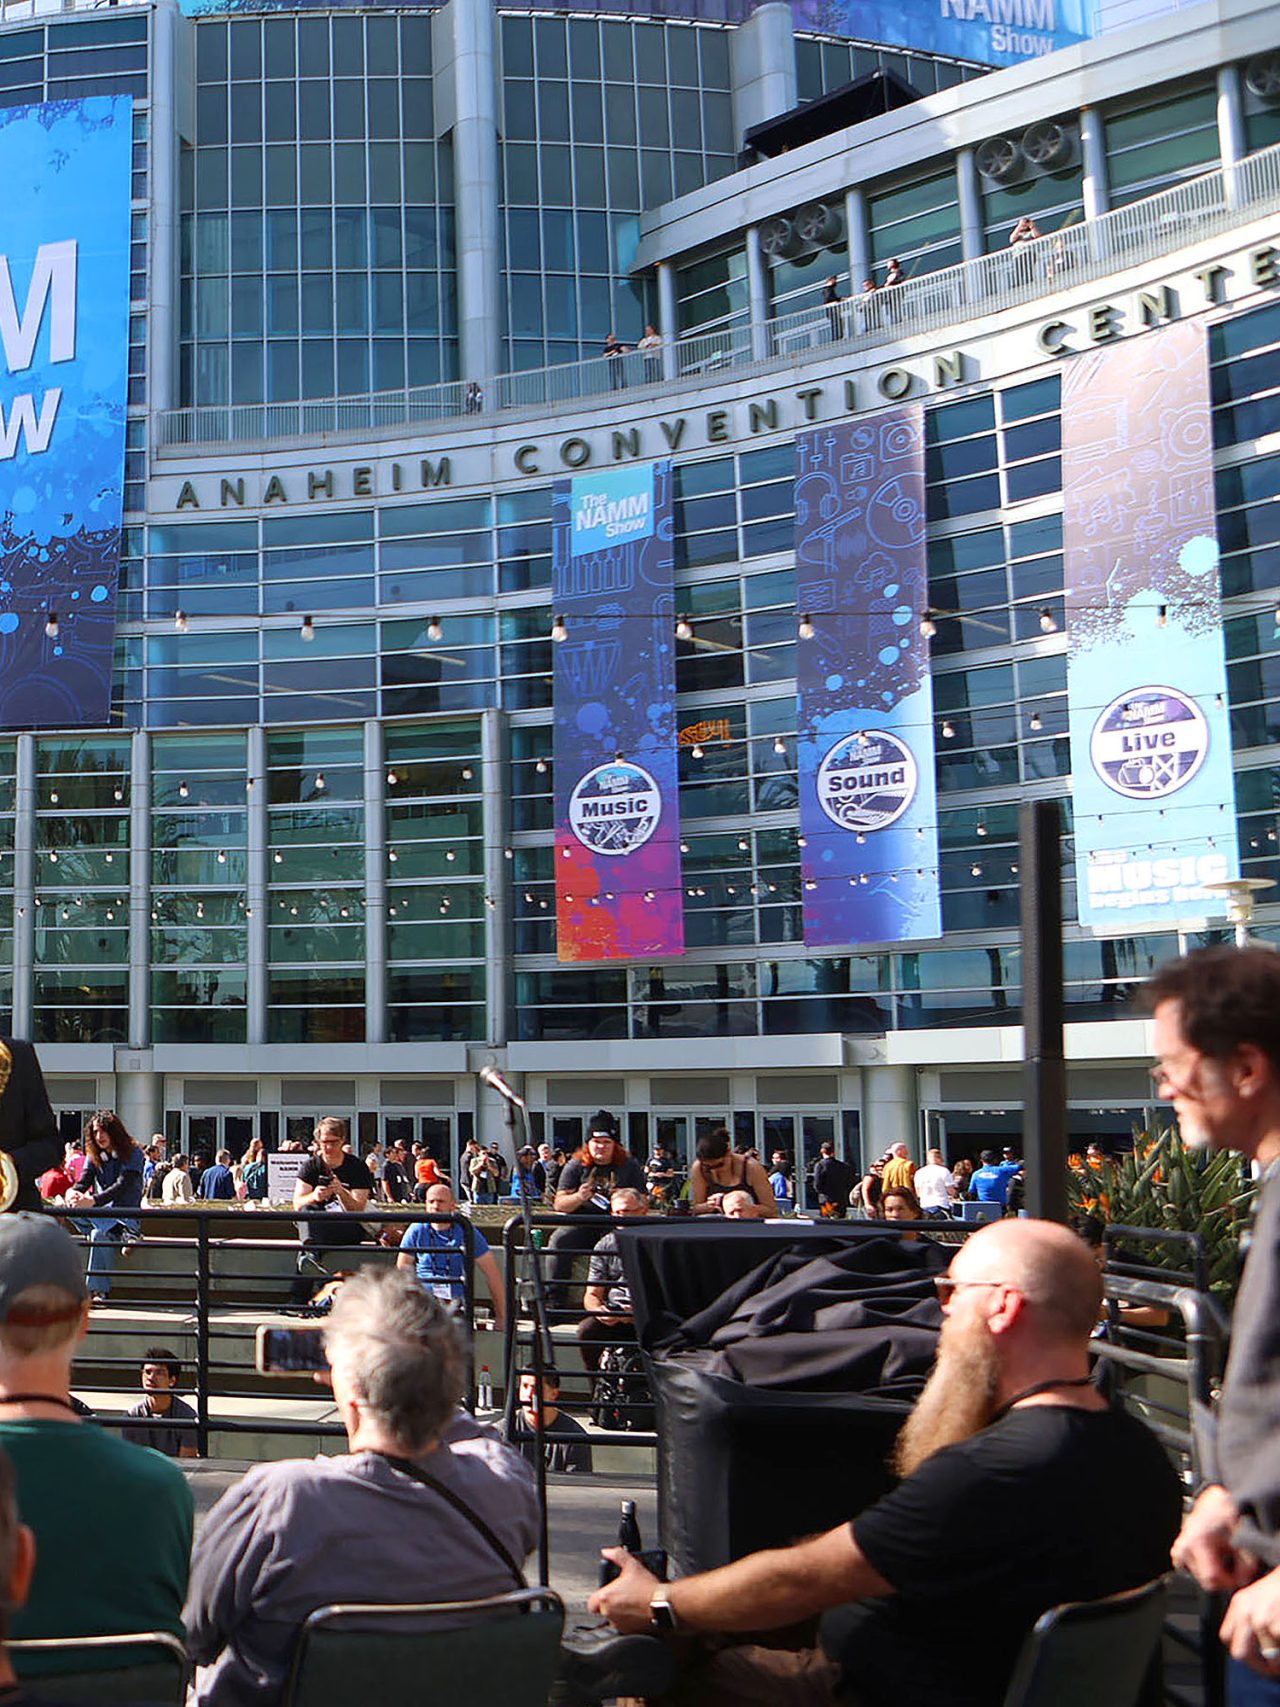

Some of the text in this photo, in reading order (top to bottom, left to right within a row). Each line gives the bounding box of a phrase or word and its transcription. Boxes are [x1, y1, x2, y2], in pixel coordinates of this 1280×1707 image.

[990, 24, 1054, 56] Show
[176, 244, 1279, 510] ANAHEIM CONVENTION CENTE
[576, 492, 648, 532] NAMM
[580, 493, 608, 509] The
[605, 515, 648, 537] Show
[1122, 732, 1176, 753] Live
[828, 767, 905, 792] Sound
[581, 797, 648, 818] Music
[1087, 854, 1228, 892] MUSIC
